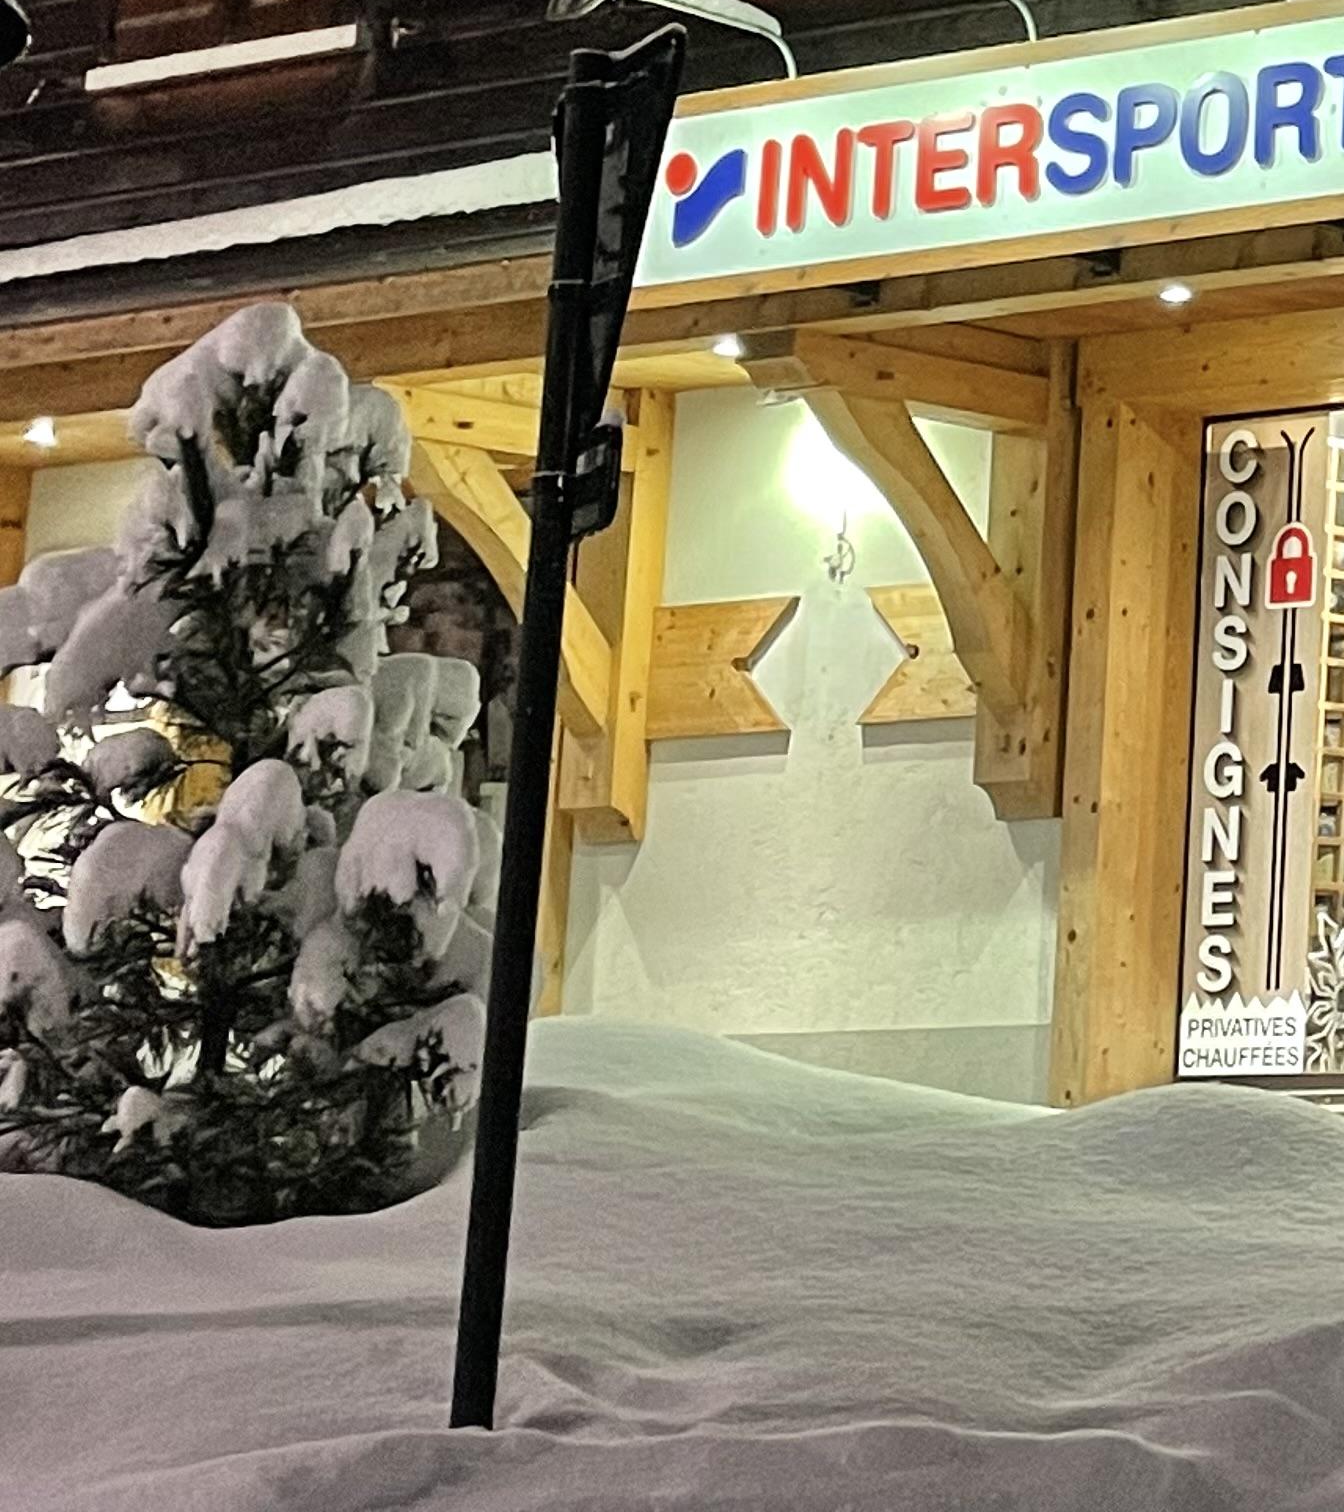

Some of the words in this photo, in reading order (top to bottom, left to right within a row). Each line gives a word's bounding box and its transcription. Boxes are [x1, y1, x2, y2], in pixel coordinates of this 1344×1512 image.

[1196, 428, 1260, 994] CONSIGNES
[1187, 1016, 1297, 1039] PRIVATIVES
[1182, 1042, 1299, 1068] CHAUFFÉES
